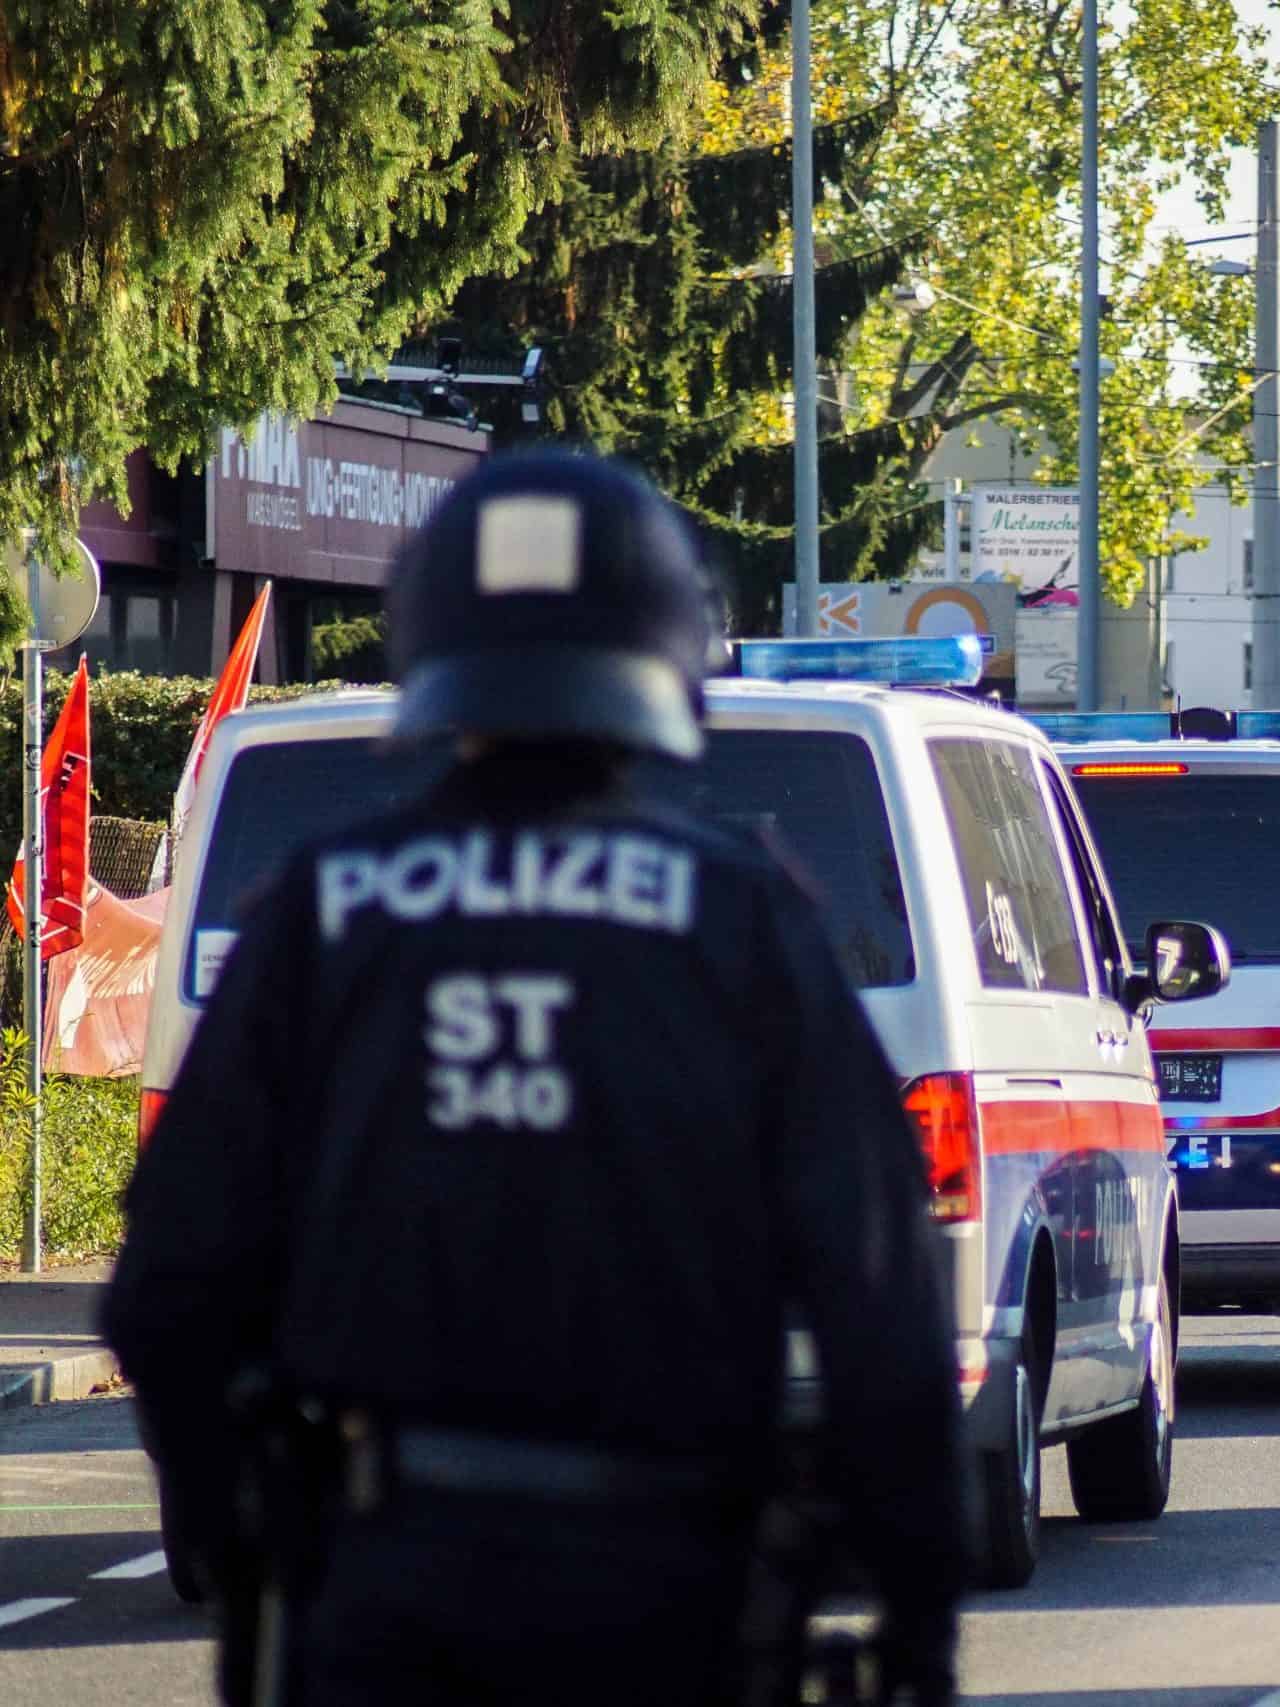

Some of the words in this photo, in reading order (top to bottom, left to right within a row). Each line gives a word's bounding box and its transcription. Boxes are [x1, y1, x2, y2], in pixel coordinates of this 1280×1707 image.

[318, 827, 696, 942] POLIZEI
[427, 973, 574, 1060] ST
[427, 1067, 572, 1130] 340
